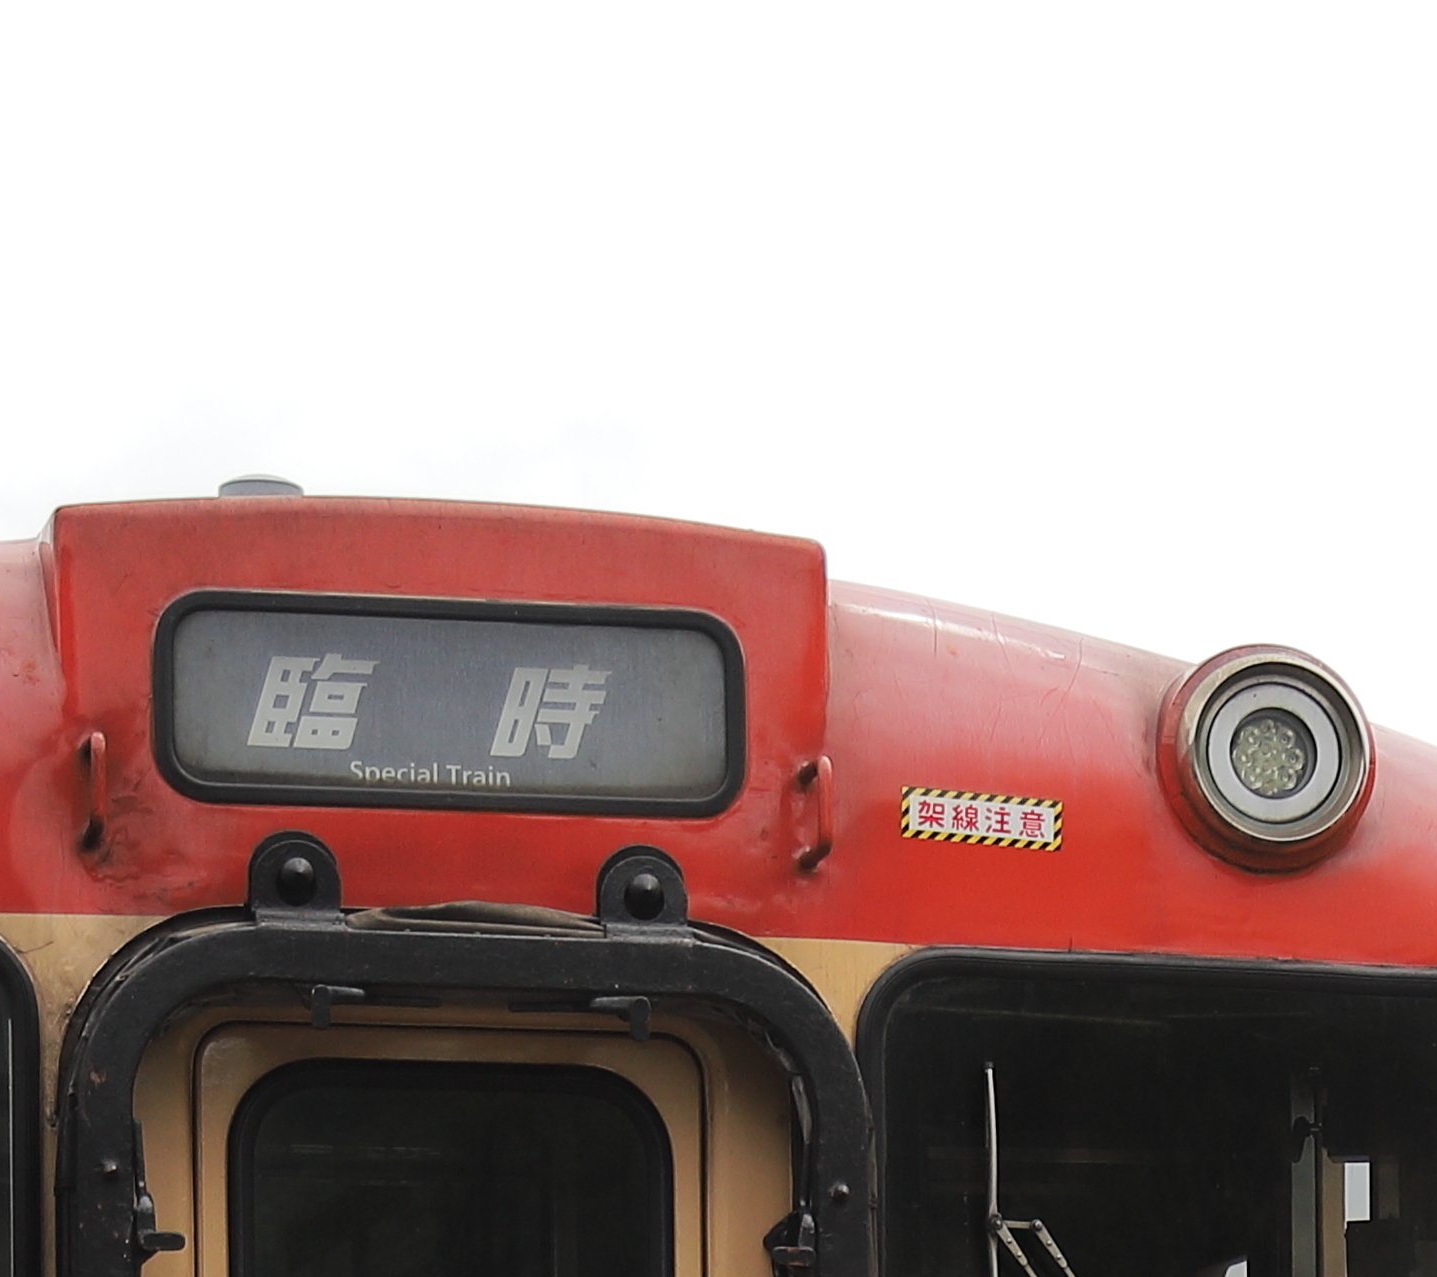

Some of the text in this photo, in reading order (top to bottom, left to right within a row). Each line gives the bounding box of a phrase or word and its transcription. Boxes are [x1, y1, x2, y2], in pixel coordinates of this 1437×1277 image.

[247, 653, 612, 760] 臨時
[349, 760, 511, 787] Special Train
[918, 800, 1046, 839] 架線注意
